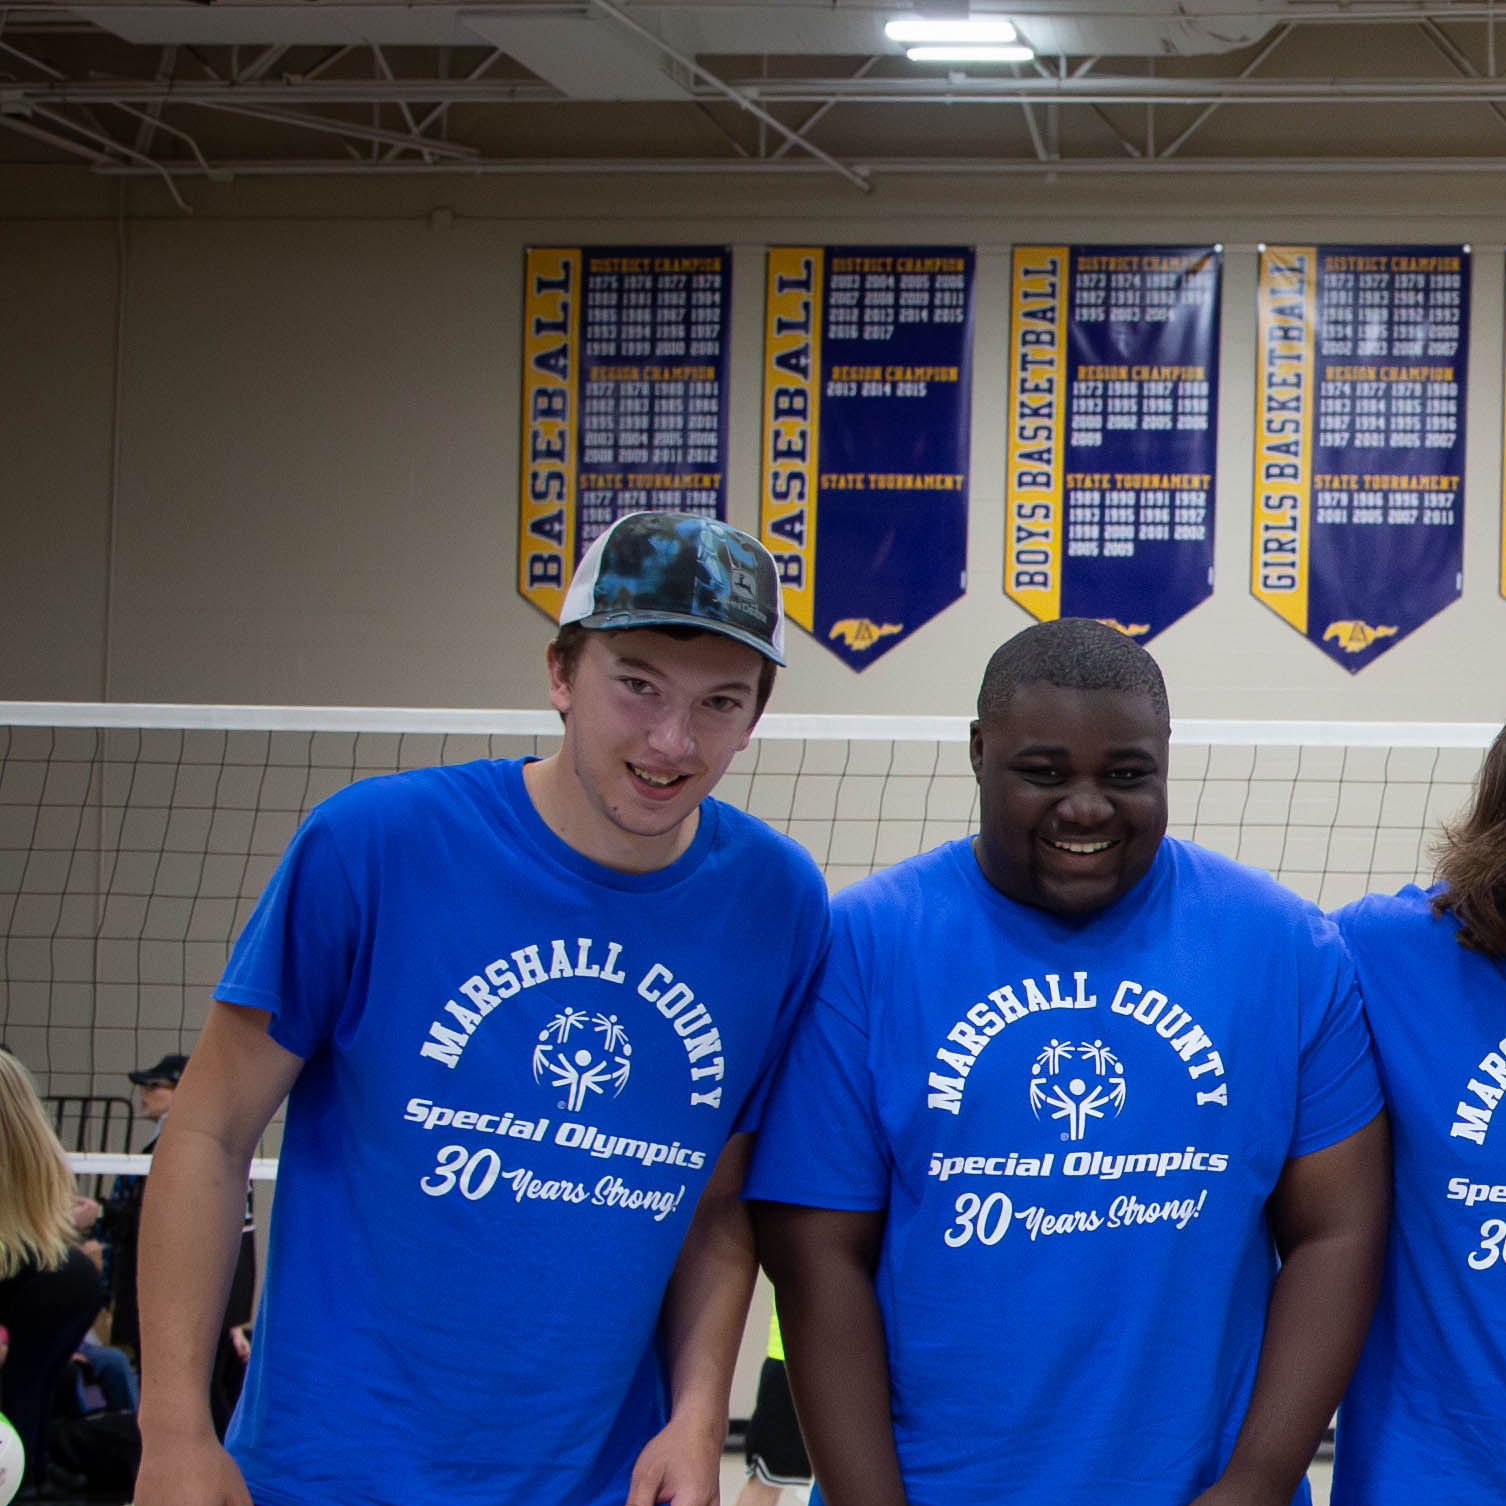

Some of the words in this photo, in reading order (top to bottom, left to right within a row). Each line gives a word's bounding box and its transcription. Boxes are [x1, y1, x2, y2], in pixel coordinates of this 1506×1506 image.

[591, 367, 640, 381] REGION
[643, 367, 715, 381] CHAMPION
[827, 383, 857, 396] 2013
[862, 383, 892, 396] 2014
[897, 383, 926, 396] 2015
[832, 367, 880, 381] REGION
[885, 367, 958, 381] CHAMPION
[1017, 257, 1060, 493] BASKETBALL
[1078, 366, 1127, 381] REGION
[1132, 366, 1204, 381] CHAMPION
[1264, 255, 1308, 483] BASKETBALL
[1325, 367, 1375, 381] REGION
[1381, 367, 1454, 381] CHAMPION
[526, 257, 573, 591] BASEBALL
[768, 257, 814, 591] BASEBALL
[580, 475, 622, 489] STATE
[626, 475, 721, 489] TOURNAMENT
[821, 475, 864, 489] STATE
[868, 475, 963, 490] TOURNAMENT
[1067, 475, 1111, 489] STATE
[1115, 475, 1211, 490] TOURNAMENT
[1315, 475, 1359, 490] STATE
[1363, 475, 1459, 490] TOURNAMENT
[1013, 501, 1053, 592] BOYS
[1261, 491, 1299, 593] GIRLS
[420, 938, 625, 1069] MARSHALL
[637, 963, 724, 1109] COUNTY
[928, 971, 1096, 1115] MARSHALL
[1111, 980, 1228, 1106] COUNTY
[404, 1098, 550, 1141] Special
[555, 1122, 706, 1169] Olympics
[420, 1145, 501, 1200] 30
[502, 1168, 588, 1202] Years
[591, 1175, 685, 1221] Strong!
[928, 1152, 1054, 1181] Special
[1063, 1146, 1228, 1180] Olympics
[944, 1192, 1012, 1247] 30
[1014, 1206, 1104, 1241] Years
[1107, 1189, 1207, 1230] Strong!
